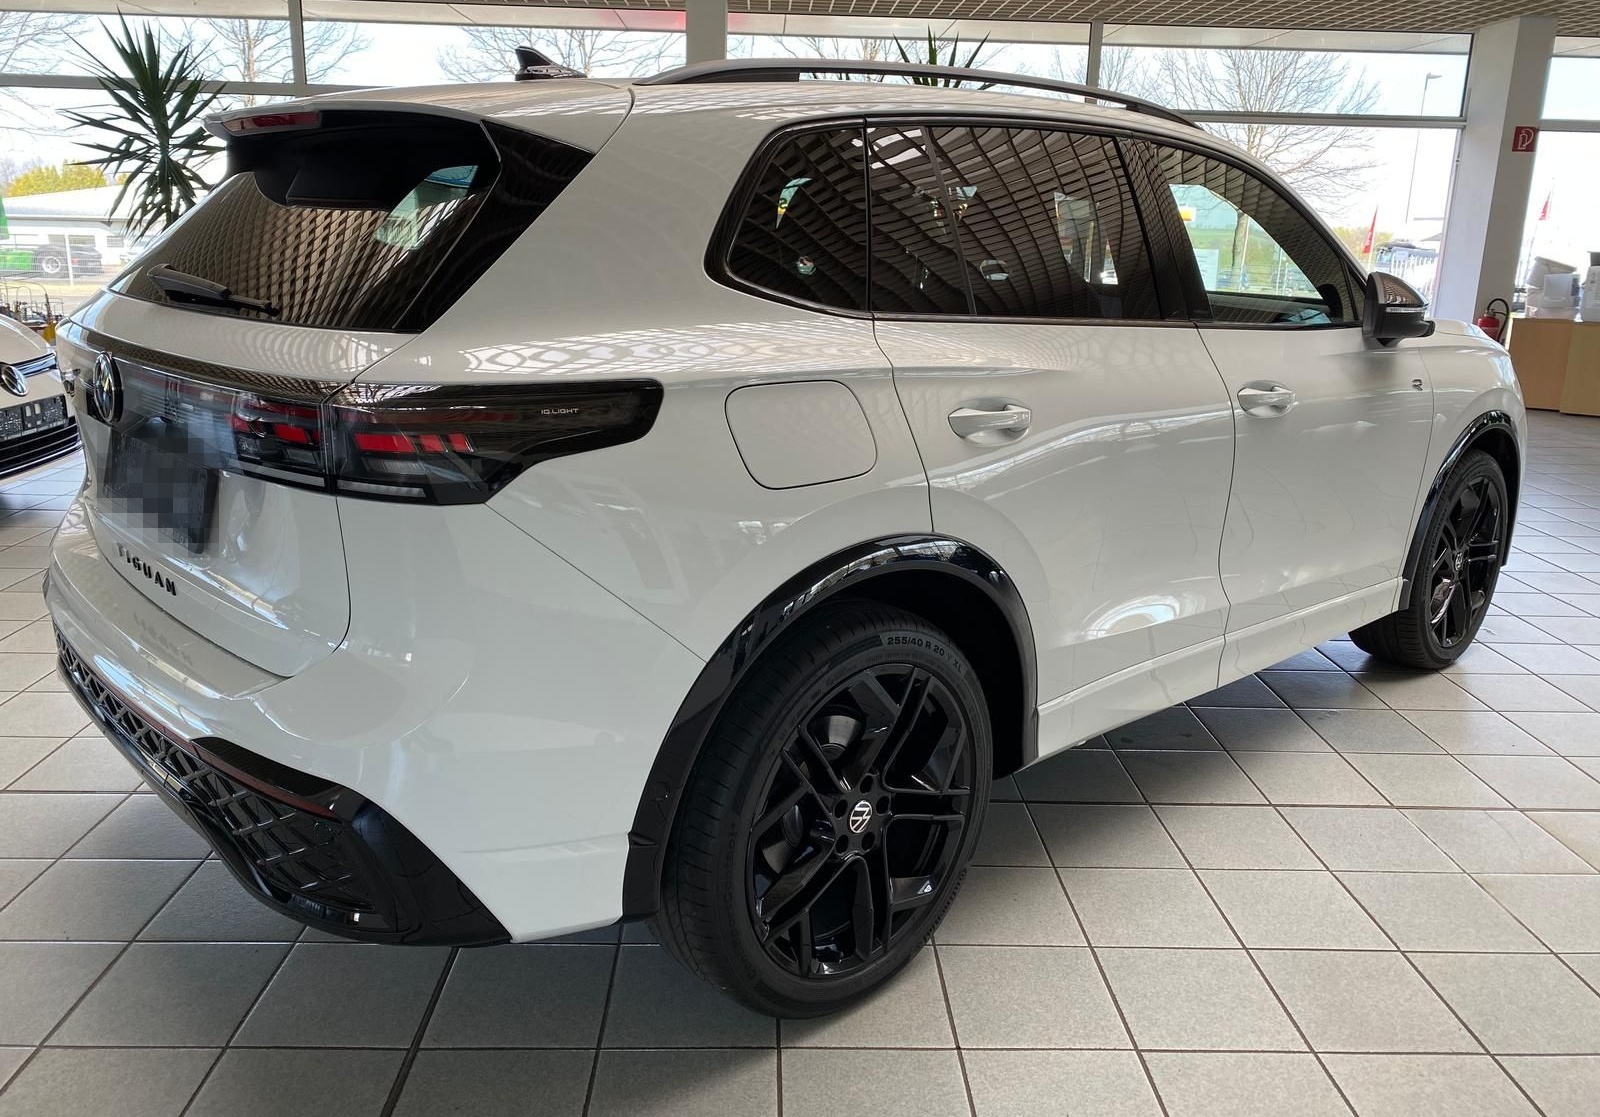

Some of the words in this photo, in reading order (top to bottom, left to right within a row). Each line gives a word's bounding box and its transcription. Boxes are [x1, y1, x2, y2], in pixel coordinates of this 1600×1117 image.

[116, 541, 177, 596] TIGUAN
[887, 636, 924, 648] 255/40
[924, 641, 932, 650] R
[933, 645, 945, 657] 20
